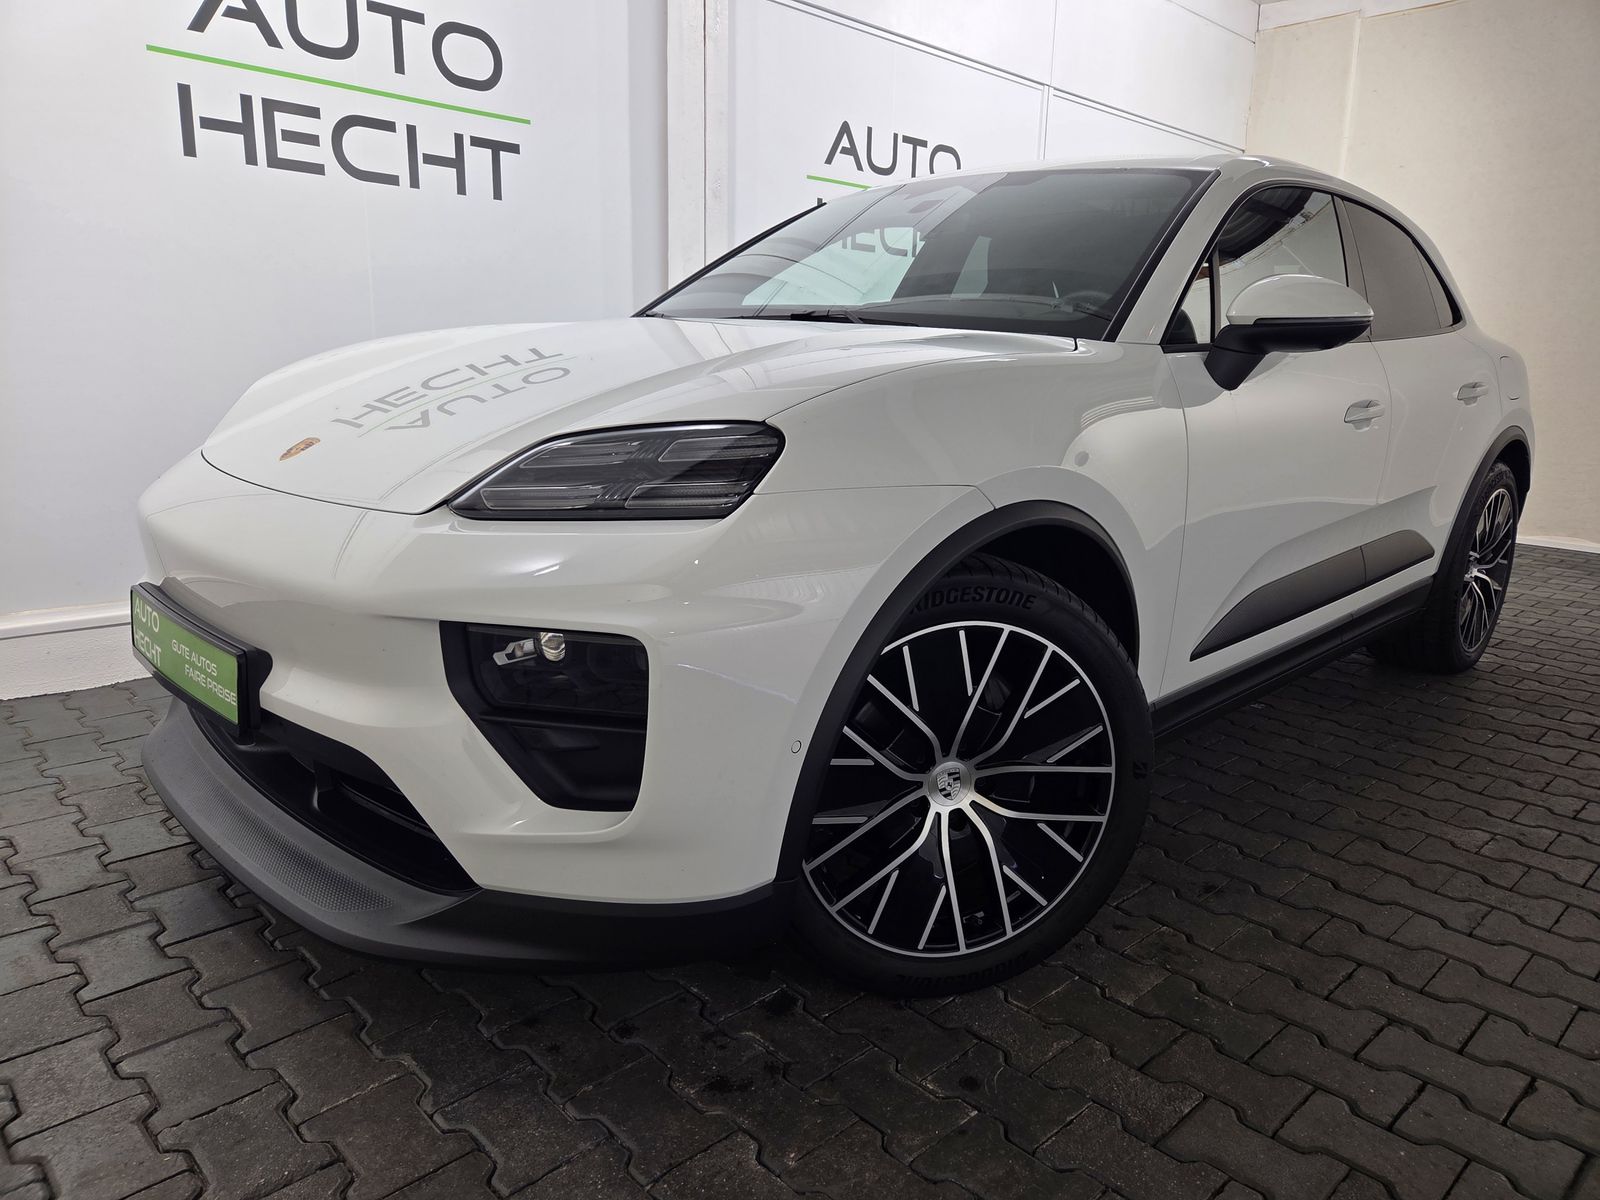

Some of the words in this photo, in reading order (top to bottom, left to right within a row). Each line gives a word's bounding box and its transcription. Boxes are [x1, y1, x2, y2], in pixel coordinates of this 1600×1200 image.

[176, 82, 521, 201] HECHT
[824, 120, 962, 178] AUTO
[134, 597, 160, 633] AUTO
[909, 585, 1037, 615] RIDGESTONE
[133, 624, 161, 667] HECHT
[171, 639, 190, 660] GUTE
[190, 651, 217, 676] AUTOS
[184, 664, 206, 687] FAIRE
[207, 677, 237, 706] PREISE
